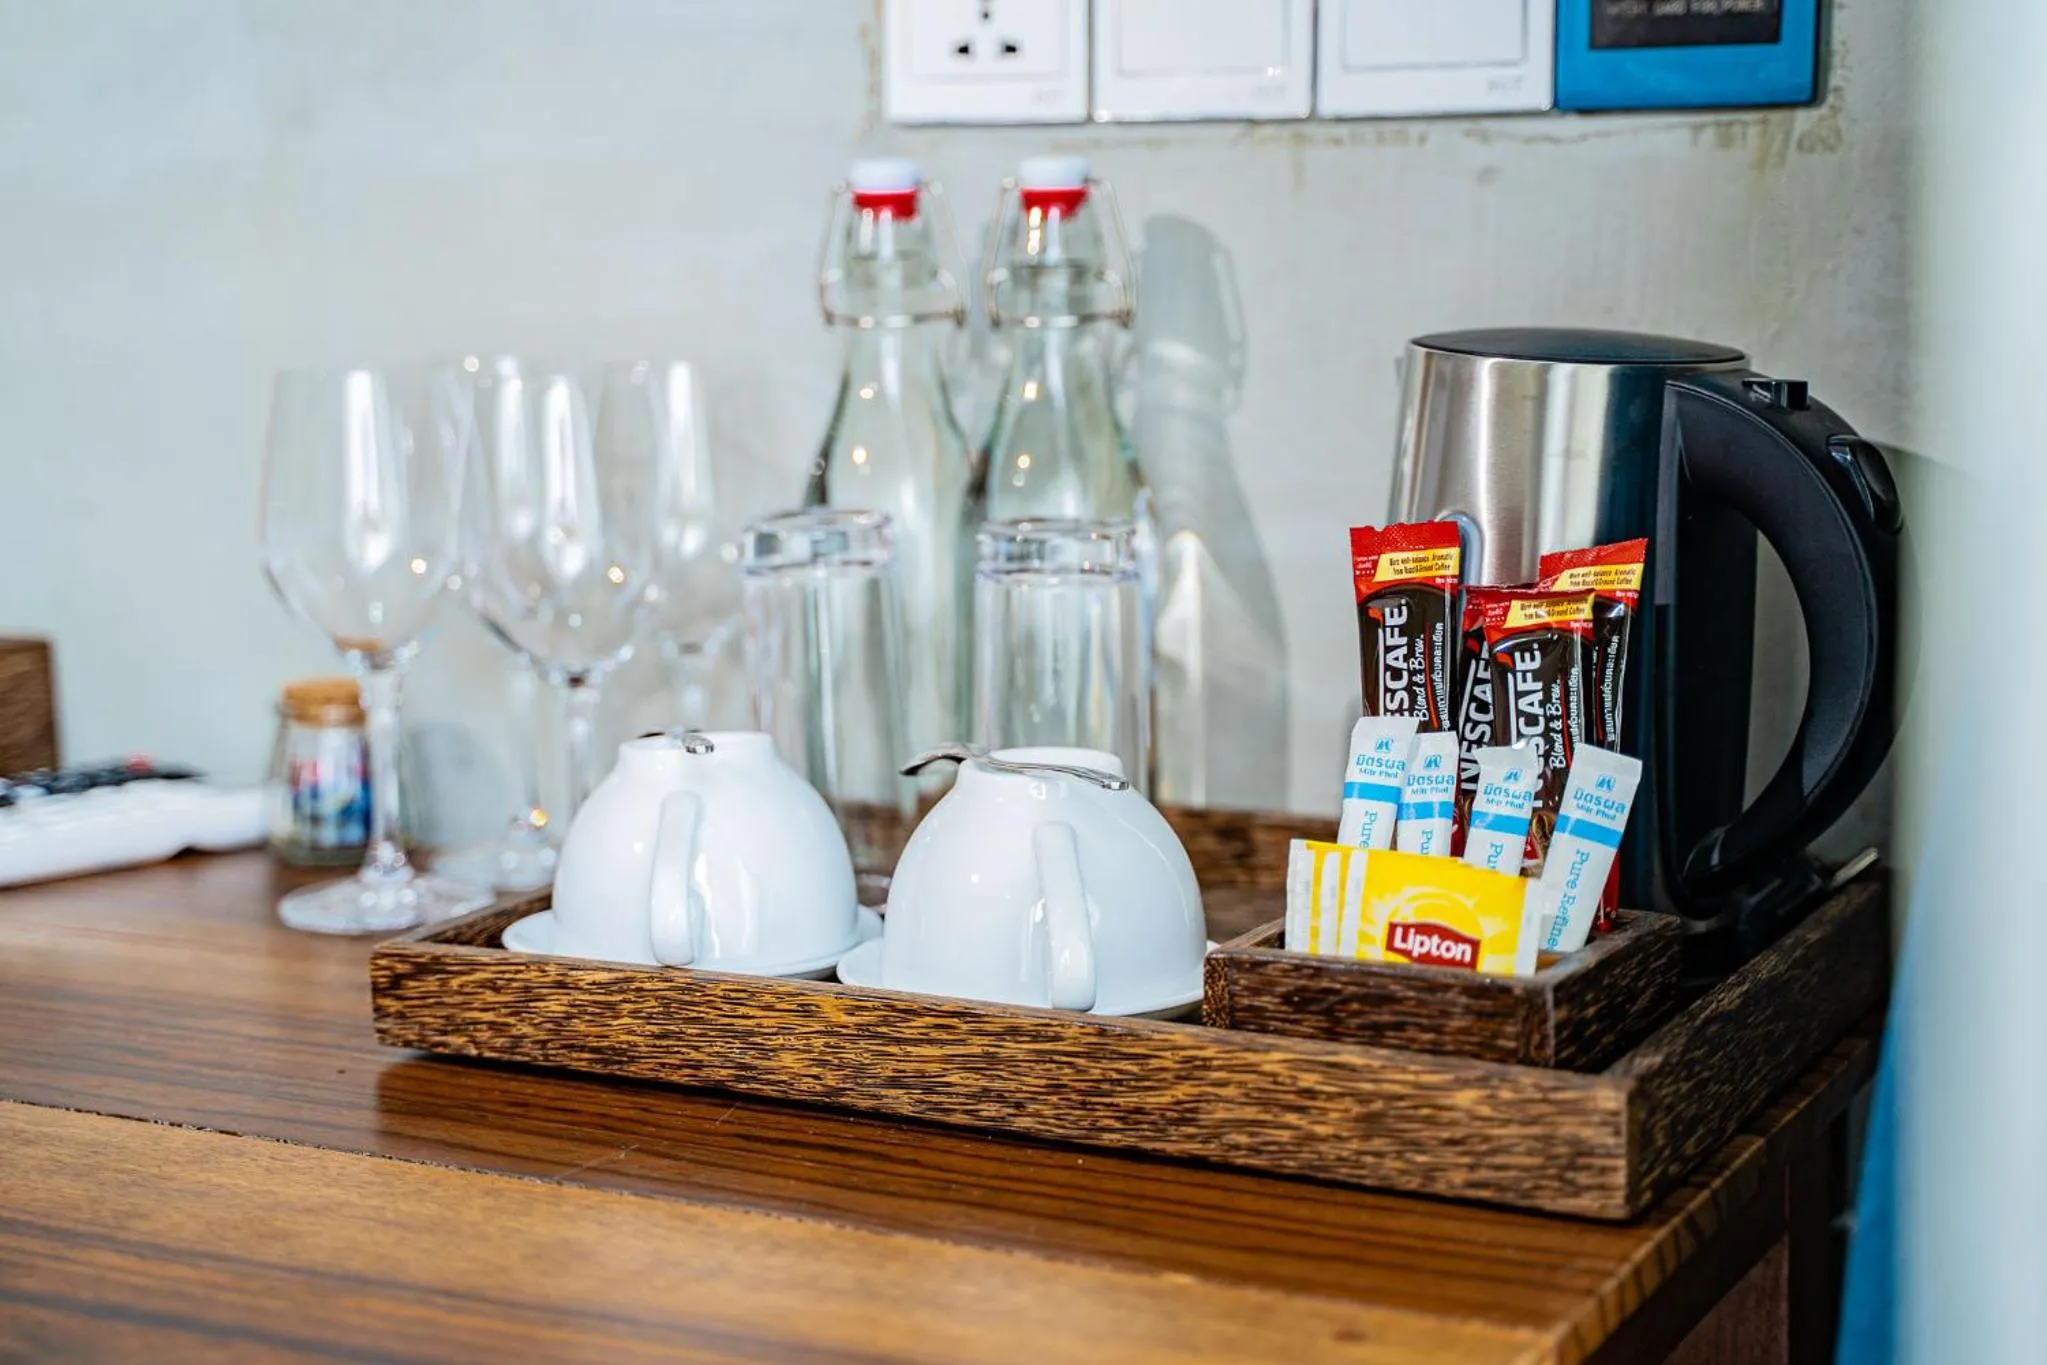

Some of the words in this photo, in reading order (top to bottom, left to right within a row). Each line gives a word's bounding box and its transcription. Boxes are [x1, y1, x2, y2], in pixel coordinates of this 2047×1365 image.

[1420, 829, 1434, 855] Pu
[1565, 848, 1590, 890] Pure
[1392, 925, 1473, 964] Lipton
